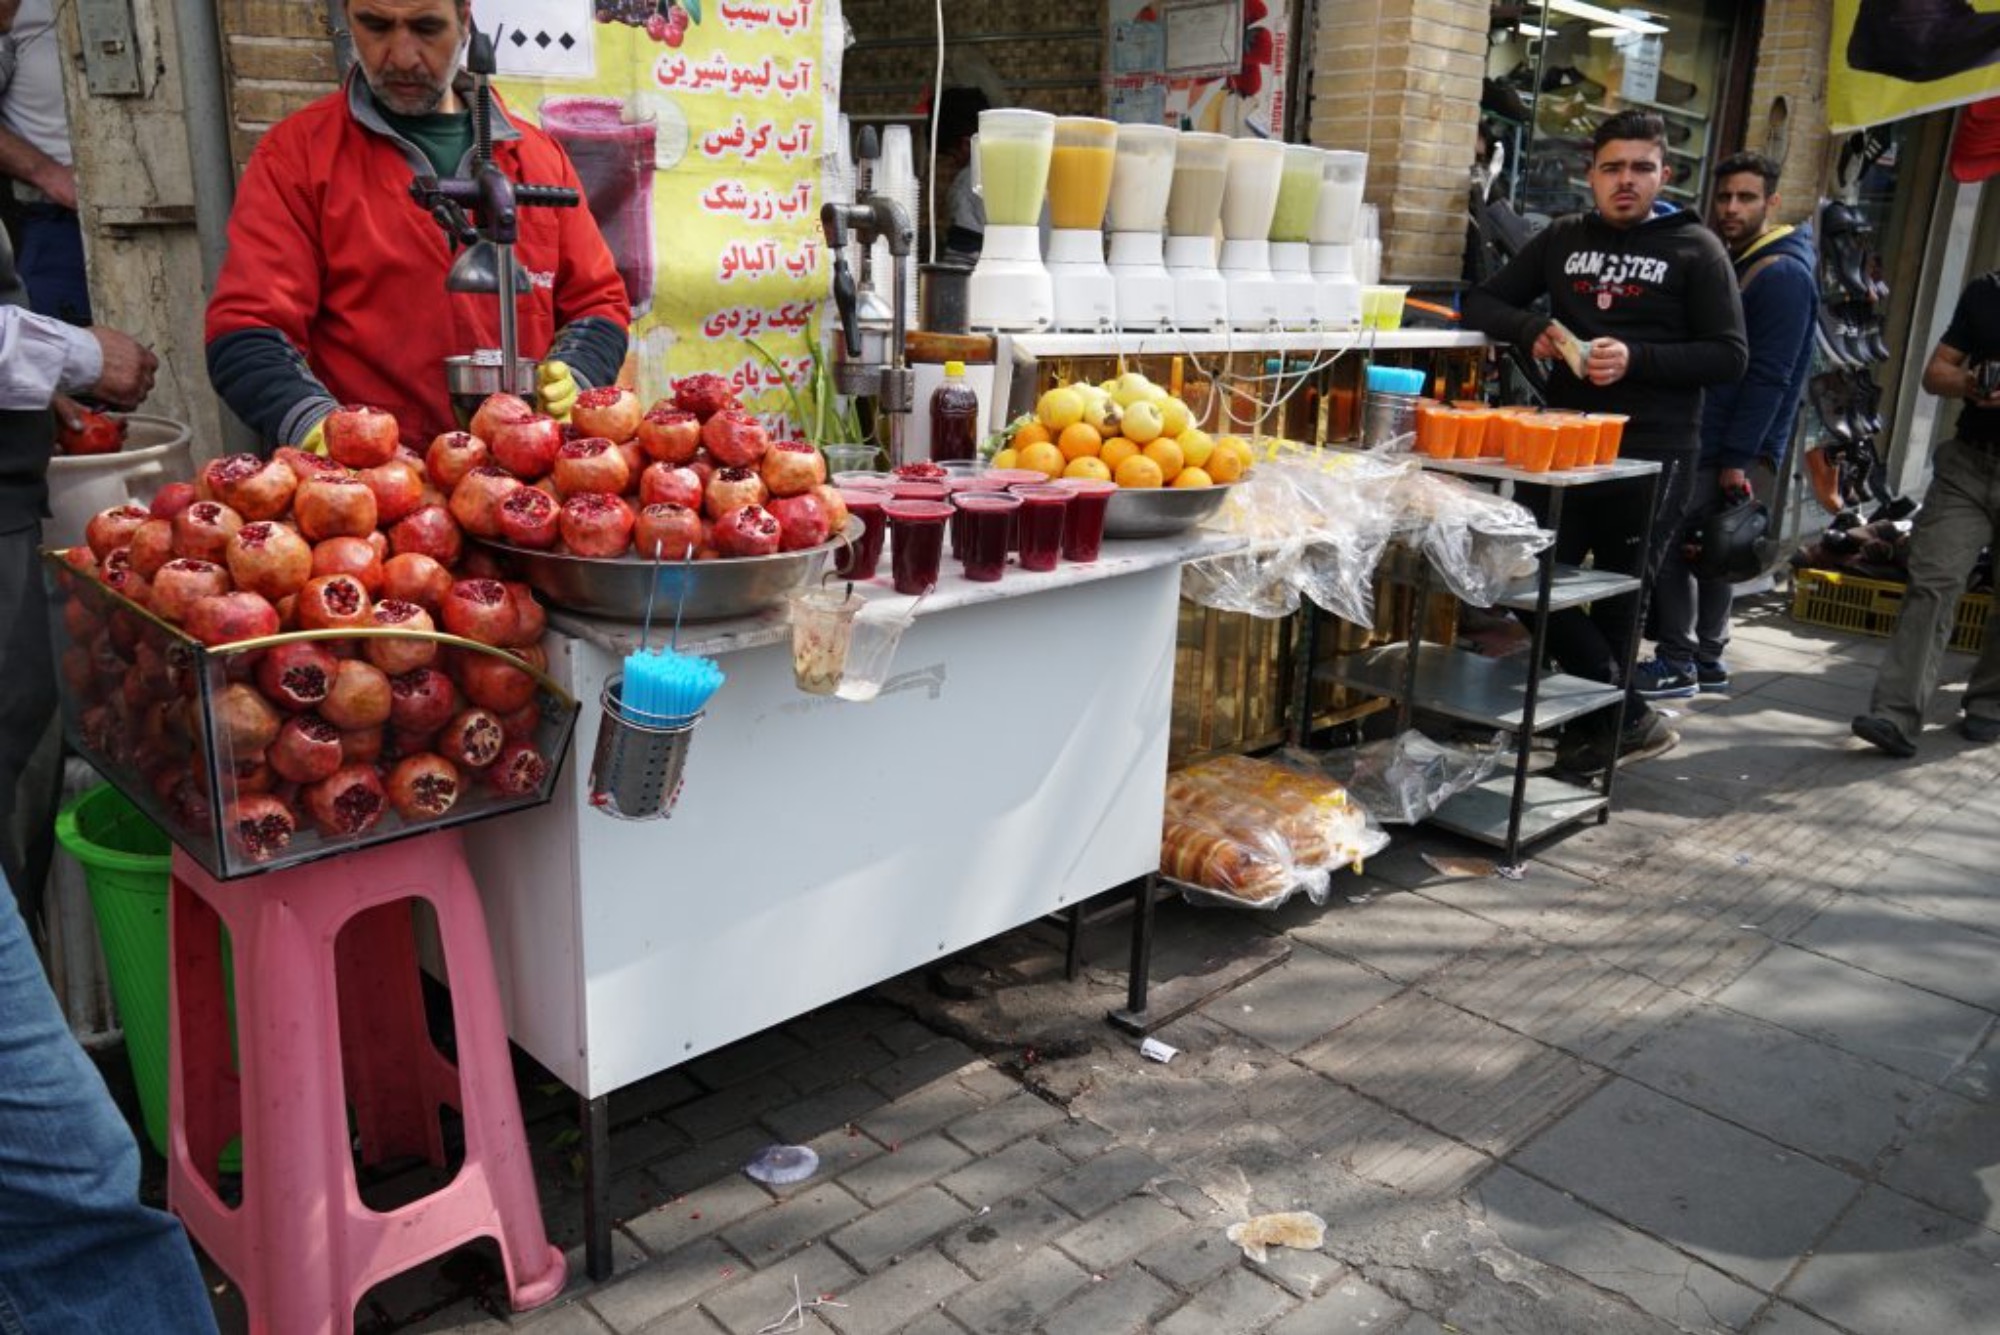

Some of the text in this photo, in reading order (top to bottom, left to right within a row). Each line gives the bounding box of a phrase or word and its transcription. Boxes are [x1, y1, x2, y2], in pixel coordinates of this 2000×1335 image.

[722, 0, 811, 34] آب سیب
[777, 62, 812, 98] آب
[1271, 91, 1283, 133] FRAGILE
[704, 118, 812, 159] آب کرفس
[704, 184, 812, 220] آب زرشک
[720, 243, 818, 279] آب آلبالو
[1564, 251, 1669, 284] GANGSTER
[704, 303, 815, 337] کیک یزدی
